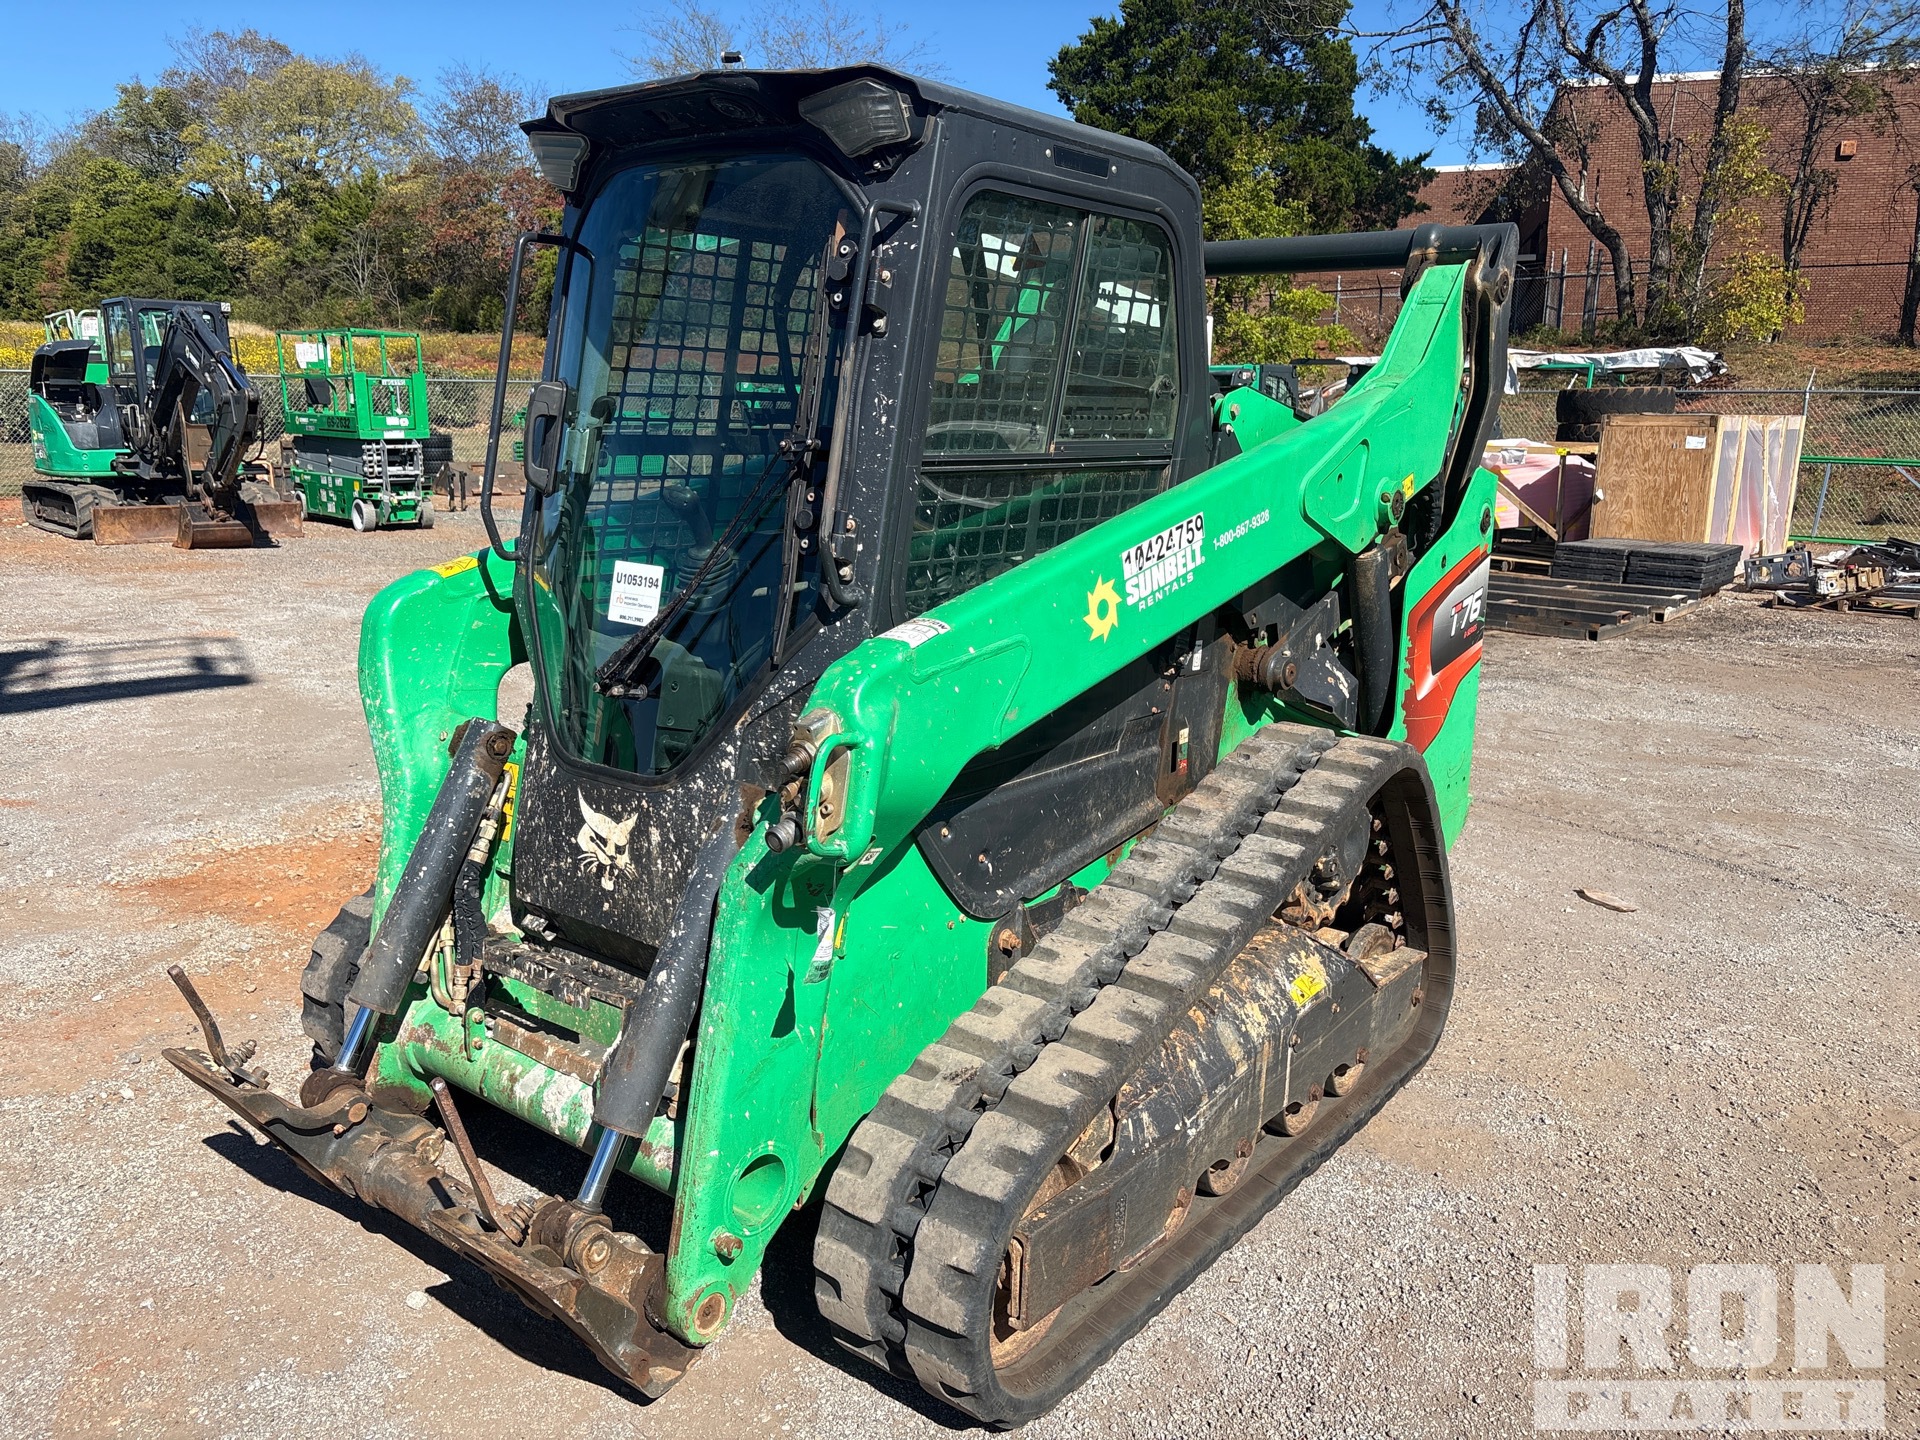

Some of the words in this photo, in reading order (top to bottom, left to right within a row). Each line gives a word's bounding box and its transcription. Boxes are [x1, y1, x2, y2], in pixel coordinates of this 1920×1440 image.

[1213, 509, 1270, 550] 1-800-667-9328
[616, 572, 659, 589] U1053194
[1126, 540, 1205, 606] SUNBELT
[1138, 571, 1194, 612] RENTALS
[1450, 587, 1484, 637] T76
